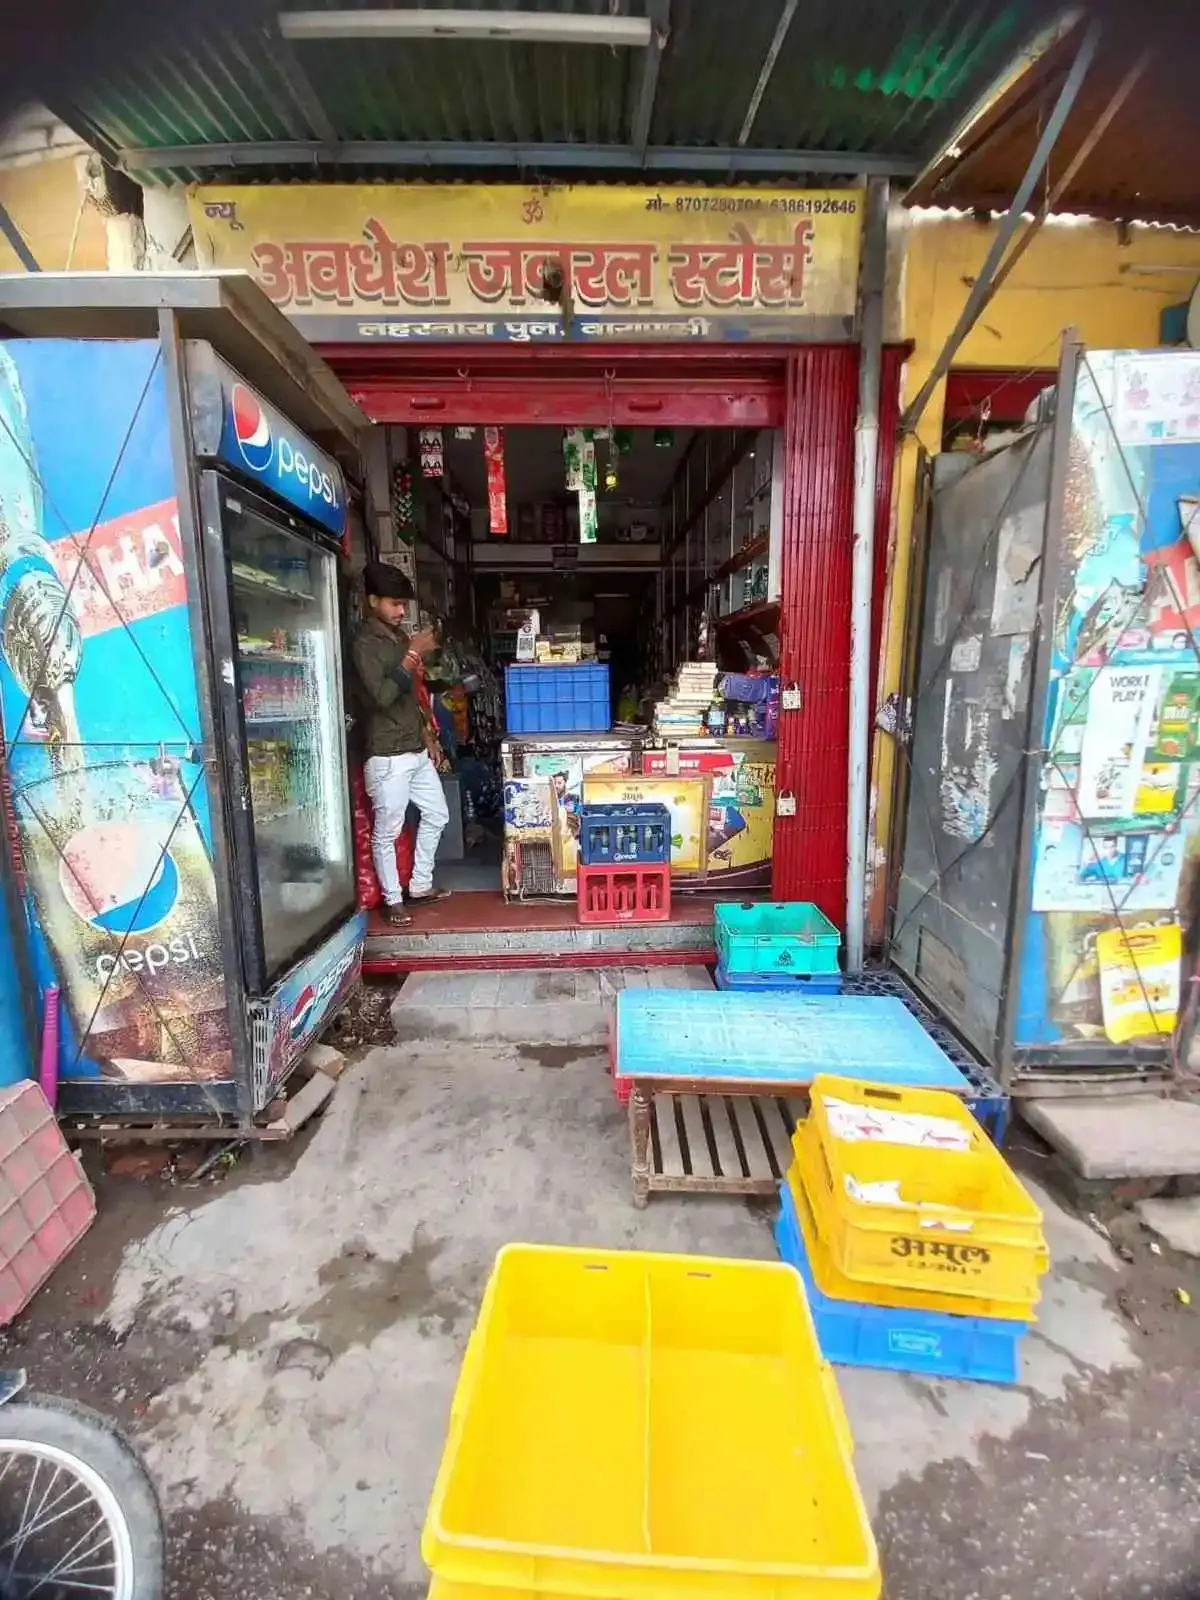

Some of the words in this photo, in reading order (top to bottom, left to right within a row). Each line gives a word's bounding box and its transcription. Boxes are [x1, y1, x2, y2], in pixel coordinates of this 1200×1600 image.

[203, 202, 245, 230] न्यू
[252, 217, 451, 307] अवधेश
[462, 241, 660, 307] जनरल
[668, 218, 814, 308] स्टोर्स
[278, 436, 338, 509] pepsi
[1112, 690, 1137, 703] PLAY
[96, 931, 200, 986] pepsi
[891, 1236, 990, 1266] अमूल
